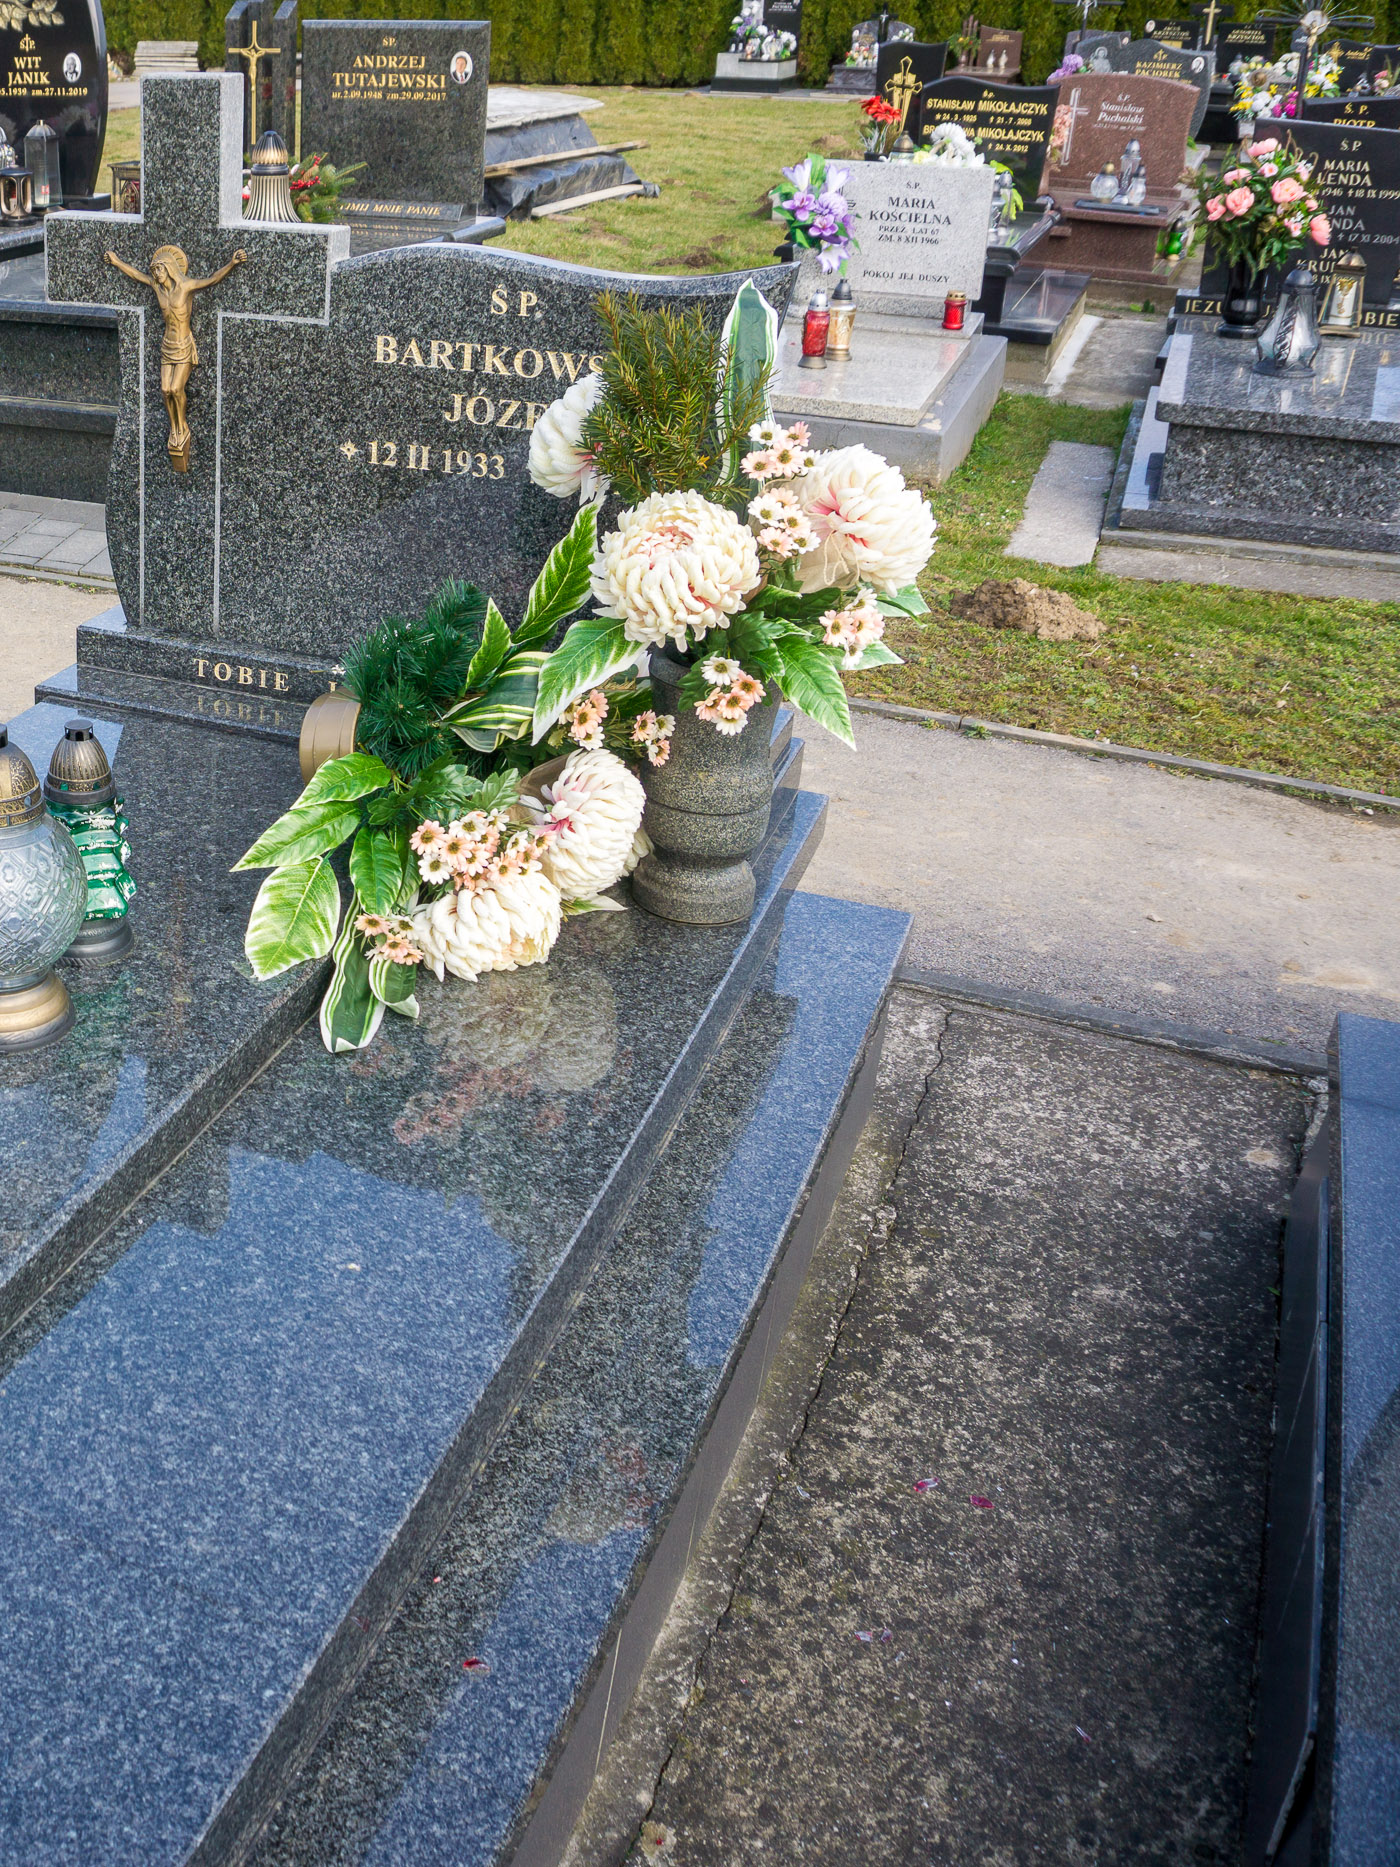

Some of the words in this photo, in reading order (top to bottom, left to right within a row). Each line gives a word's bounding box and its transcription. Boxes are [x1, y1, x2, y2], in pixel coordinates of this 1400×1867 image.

[14, 56, 41, 69] WIT
[353, 55, 426, 68] ANDRZEJ
[8, 71, 50, 87] JANIK
[332, 72, 446, 88] TUTAJEWSKI
[927, 98, 975, 111] STANISŁAW
[977, 100, 1048, 115] MIKOŁAJCZYK
[1097, 111, 1144, 124] Puchalski
[977, 127, 1045, 142] MIKOŁAJCZYK
[1323, 160, 1370, 172] MARIA
[1316, 172, 1372, 187] LENDA
[888, 196, 935, 209] MARIA
[373, 204, 404, 214] MNIE
[406, 206, 442, 216] PANIE
[869, 209, 952, 225] KOŚCIELNA
[1329, 204, 1357, 216] JAN
[1328, 217, 1365, 231] NDA
[904, 236, 918, 244] XII
[921, 237, 940, 245] 1966
[1372, 234, 1400, 245] 2004
[898, 272, 914, 281] JEJ
[918, 274, 950, 283] DUSZY
[374, 334, 605, 383] BARTKOWS
[445, 388, 550, 431] JÓZE
[368, 441, 398, 467] 12
[407, 444, 431, 471] II
[442, 448, 505, 480] 1933
[193, 658, 290, 692] TOBIE
